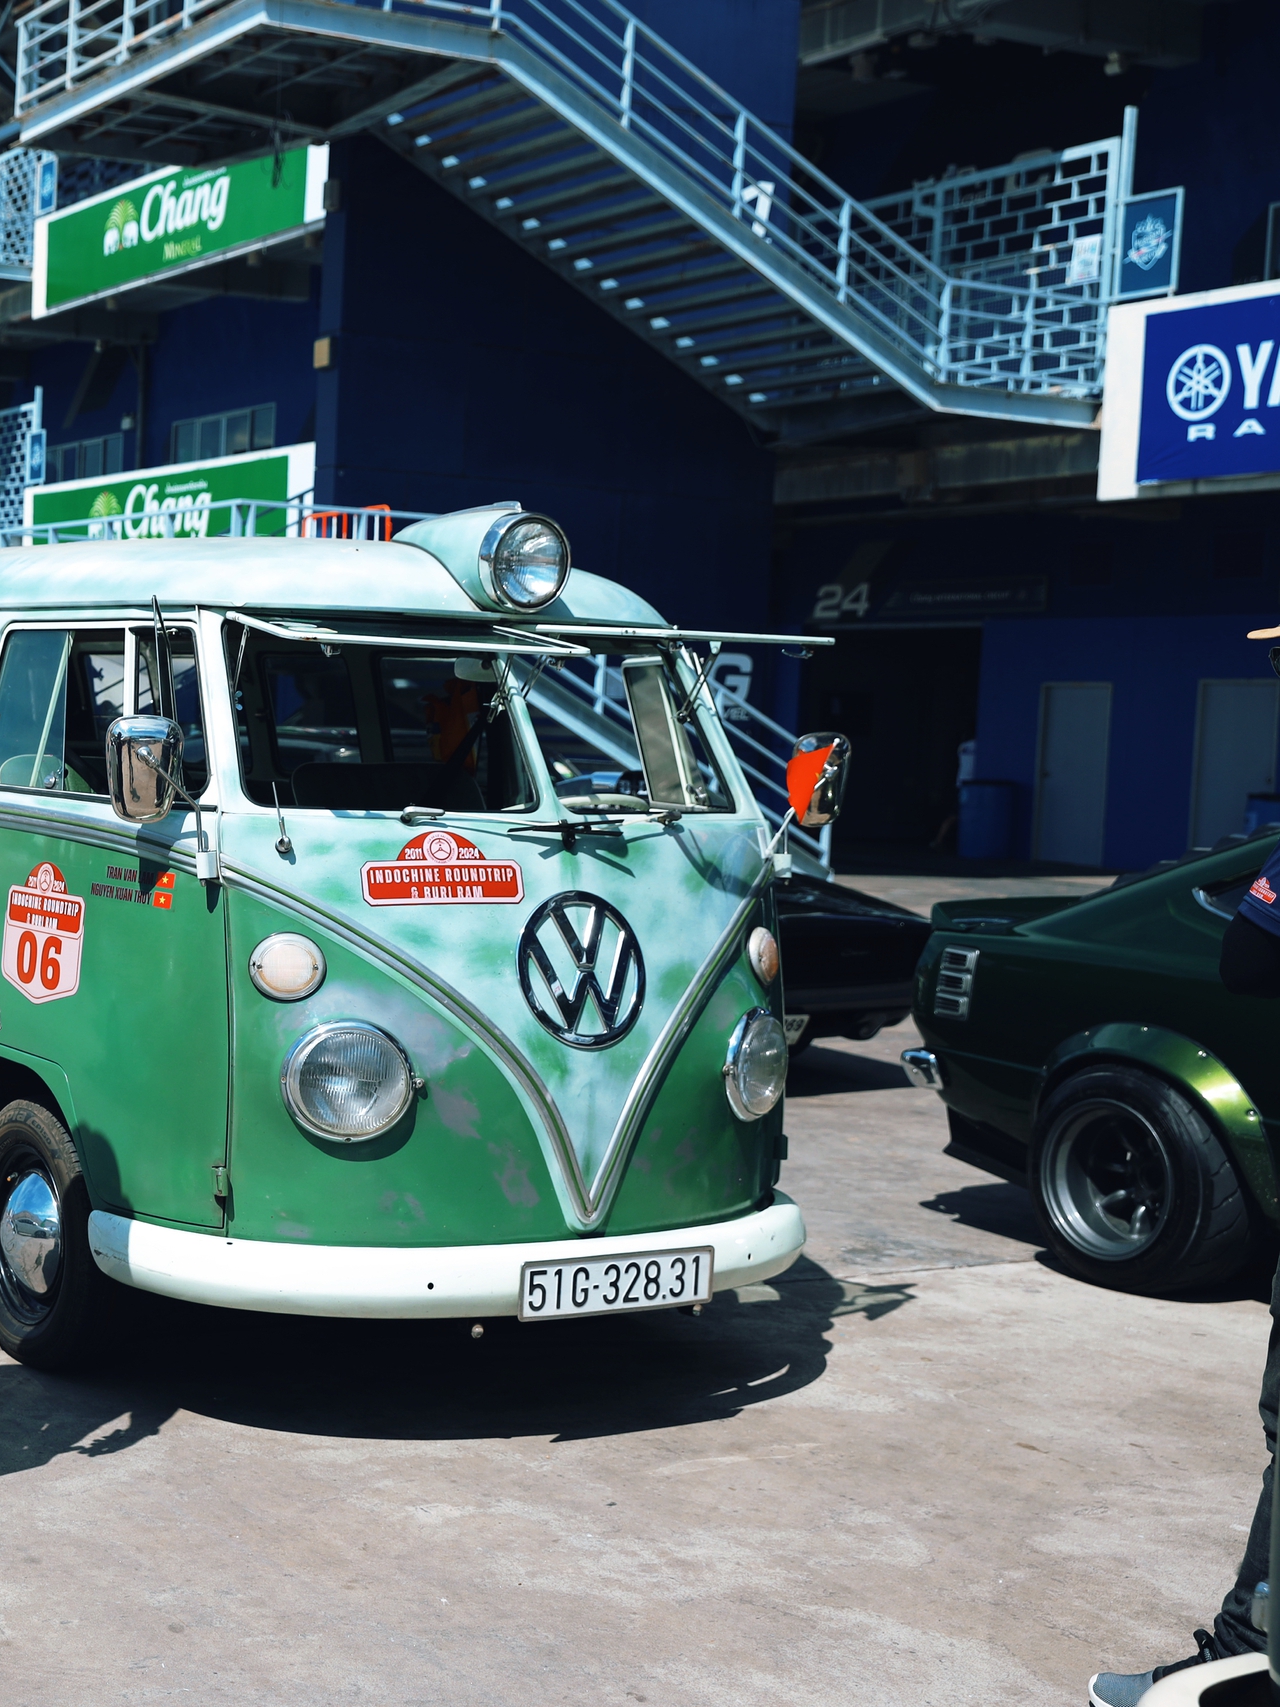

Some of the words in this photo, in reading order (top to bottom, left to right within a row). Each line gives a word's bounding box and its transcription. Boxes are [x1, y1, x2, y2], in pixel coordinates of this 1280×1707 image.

[140, 175, 231, 242] Chang
[813, 582, 869, 618] 24
[405, 848, 423, 860] 2011
[459, 847, 480, 859] 2024
[106, 865, 123, 880] TRAN
[123, 868, 137, 883] VAN
[370, 868, 441, 884] INDOCHINE
[445, 867, 514, 882] ROUNDTRIP
[91, 882, 115, 899] NGUYEN
[115, 886, 133, 902] XUAN
[424, 886, 452, 898] BURI
[457, 885, 483, 898] RAM
[12, 892, 42, 910] INDOCHINE
[43, 897, 79, 917] ROUNDTRIP
[45, 916, 58, 930] RAM
[17, 931, 62, 990] 06
[516, 890, 647, 1052] VW
[528, 1255, 700, 1312] 51G-328.31
